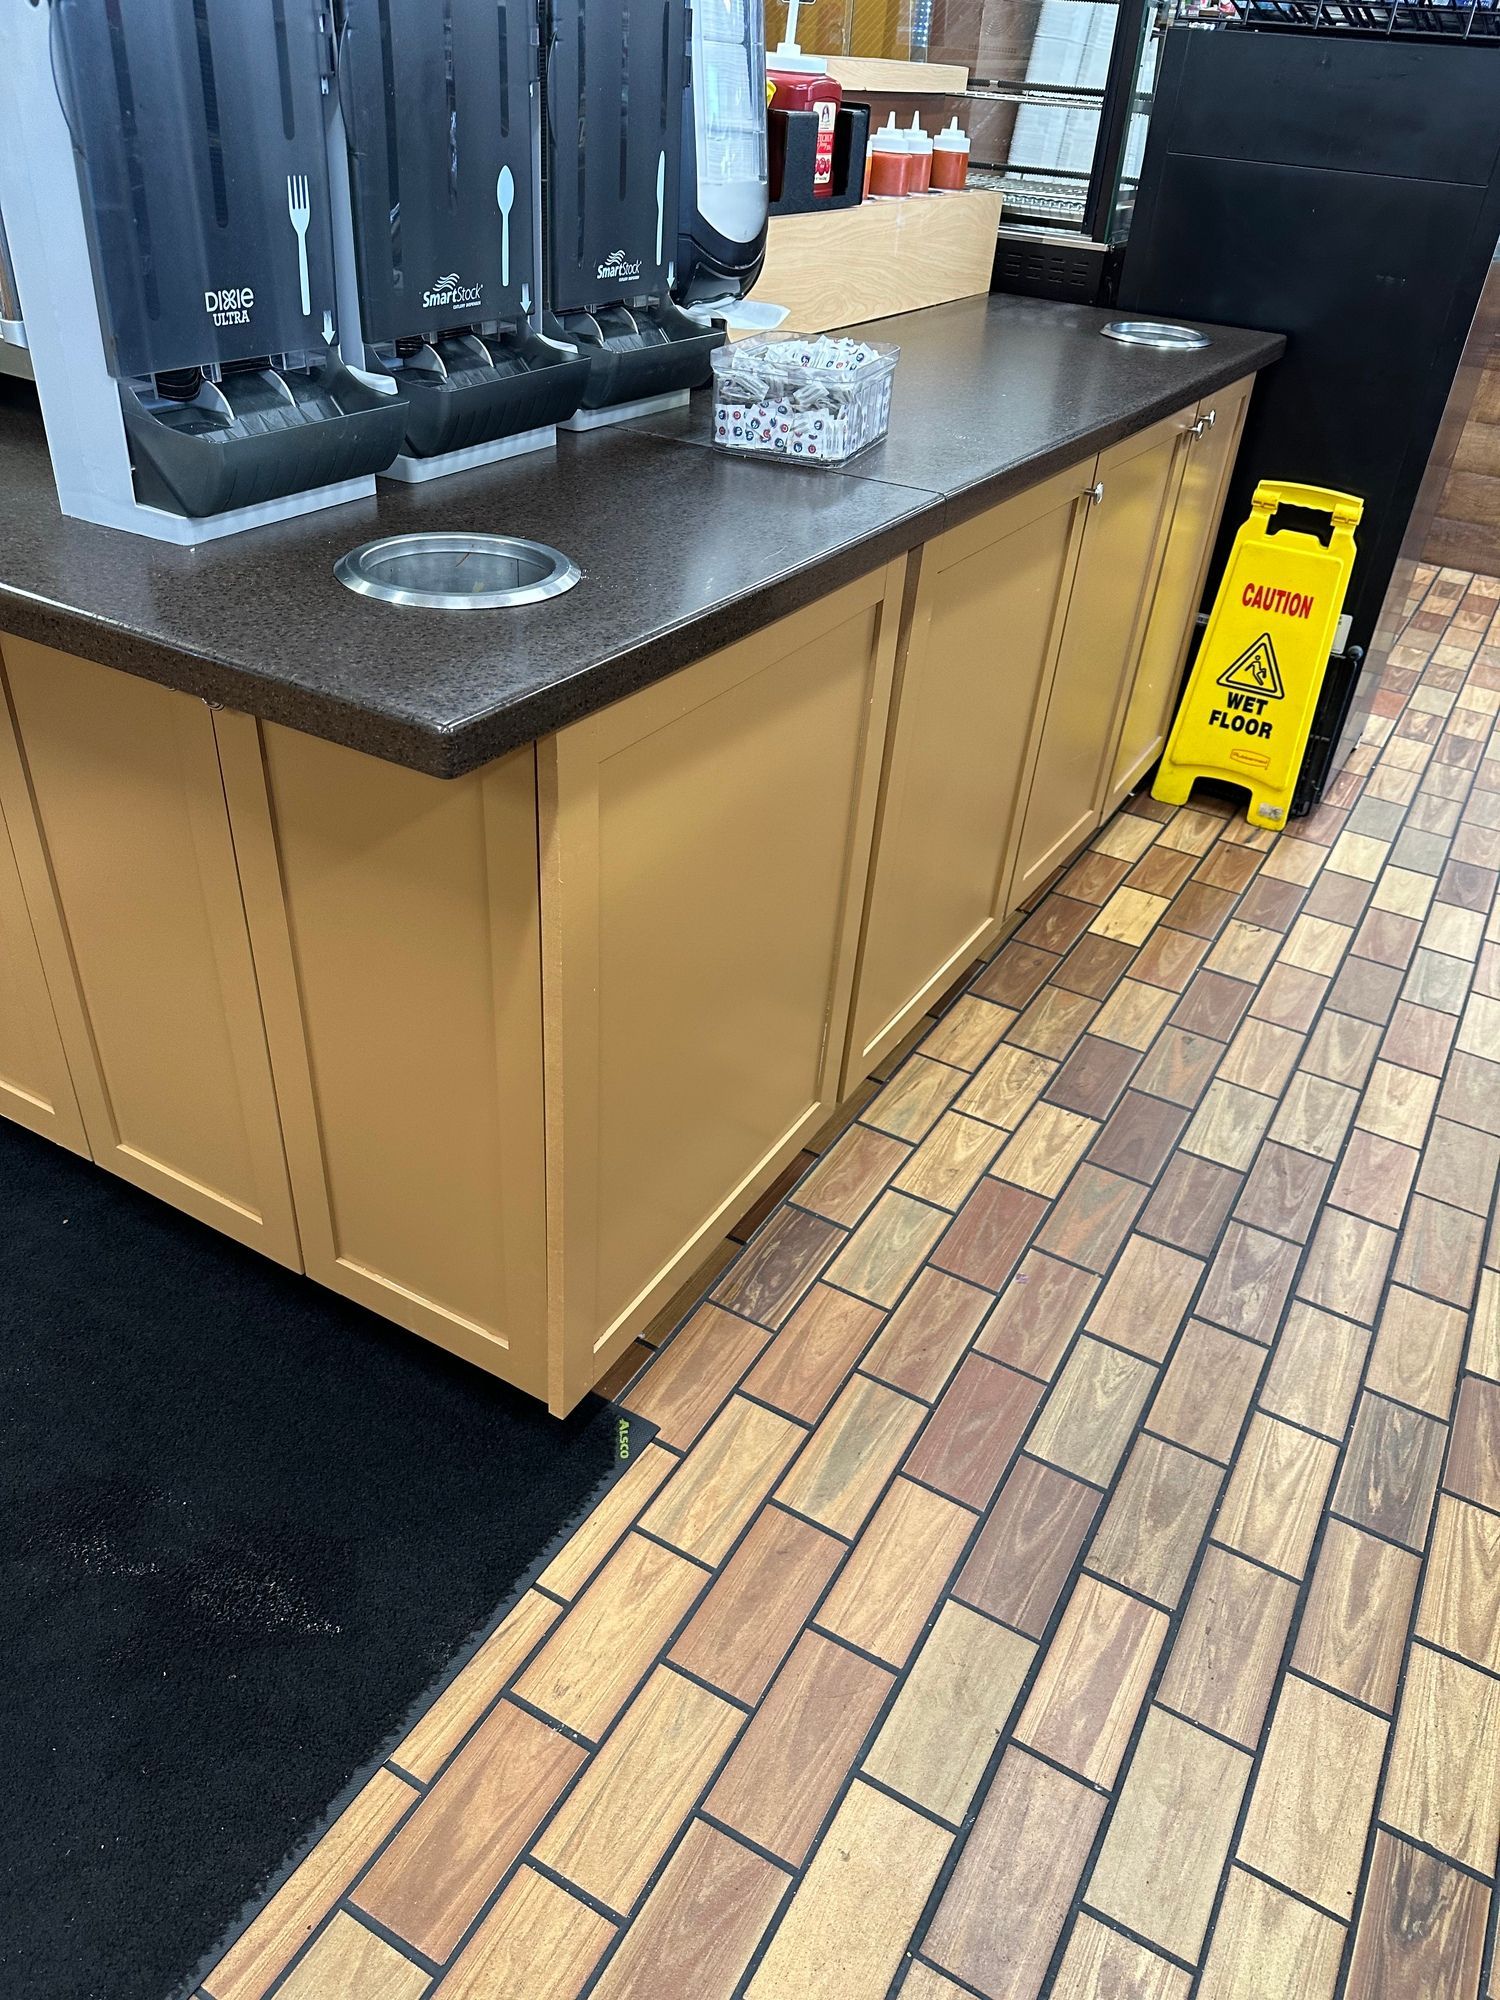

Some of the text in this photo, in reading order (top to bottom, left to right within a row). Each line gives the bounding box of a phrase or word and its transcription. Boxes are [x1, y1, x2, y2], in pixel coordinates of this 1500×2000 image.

[597, 260, 640, 279] SmartStock
[422, 283, 481, 308] SmartStock
[212, 309, 250, 327] ULTRA
[1242, 583, 1314, 619] CAUTION
[1227, 692, 1268, 715] WET
[1208, 709, 1273, 739] FLOOR
[618, 1419, 630, 1459] ALSCO
